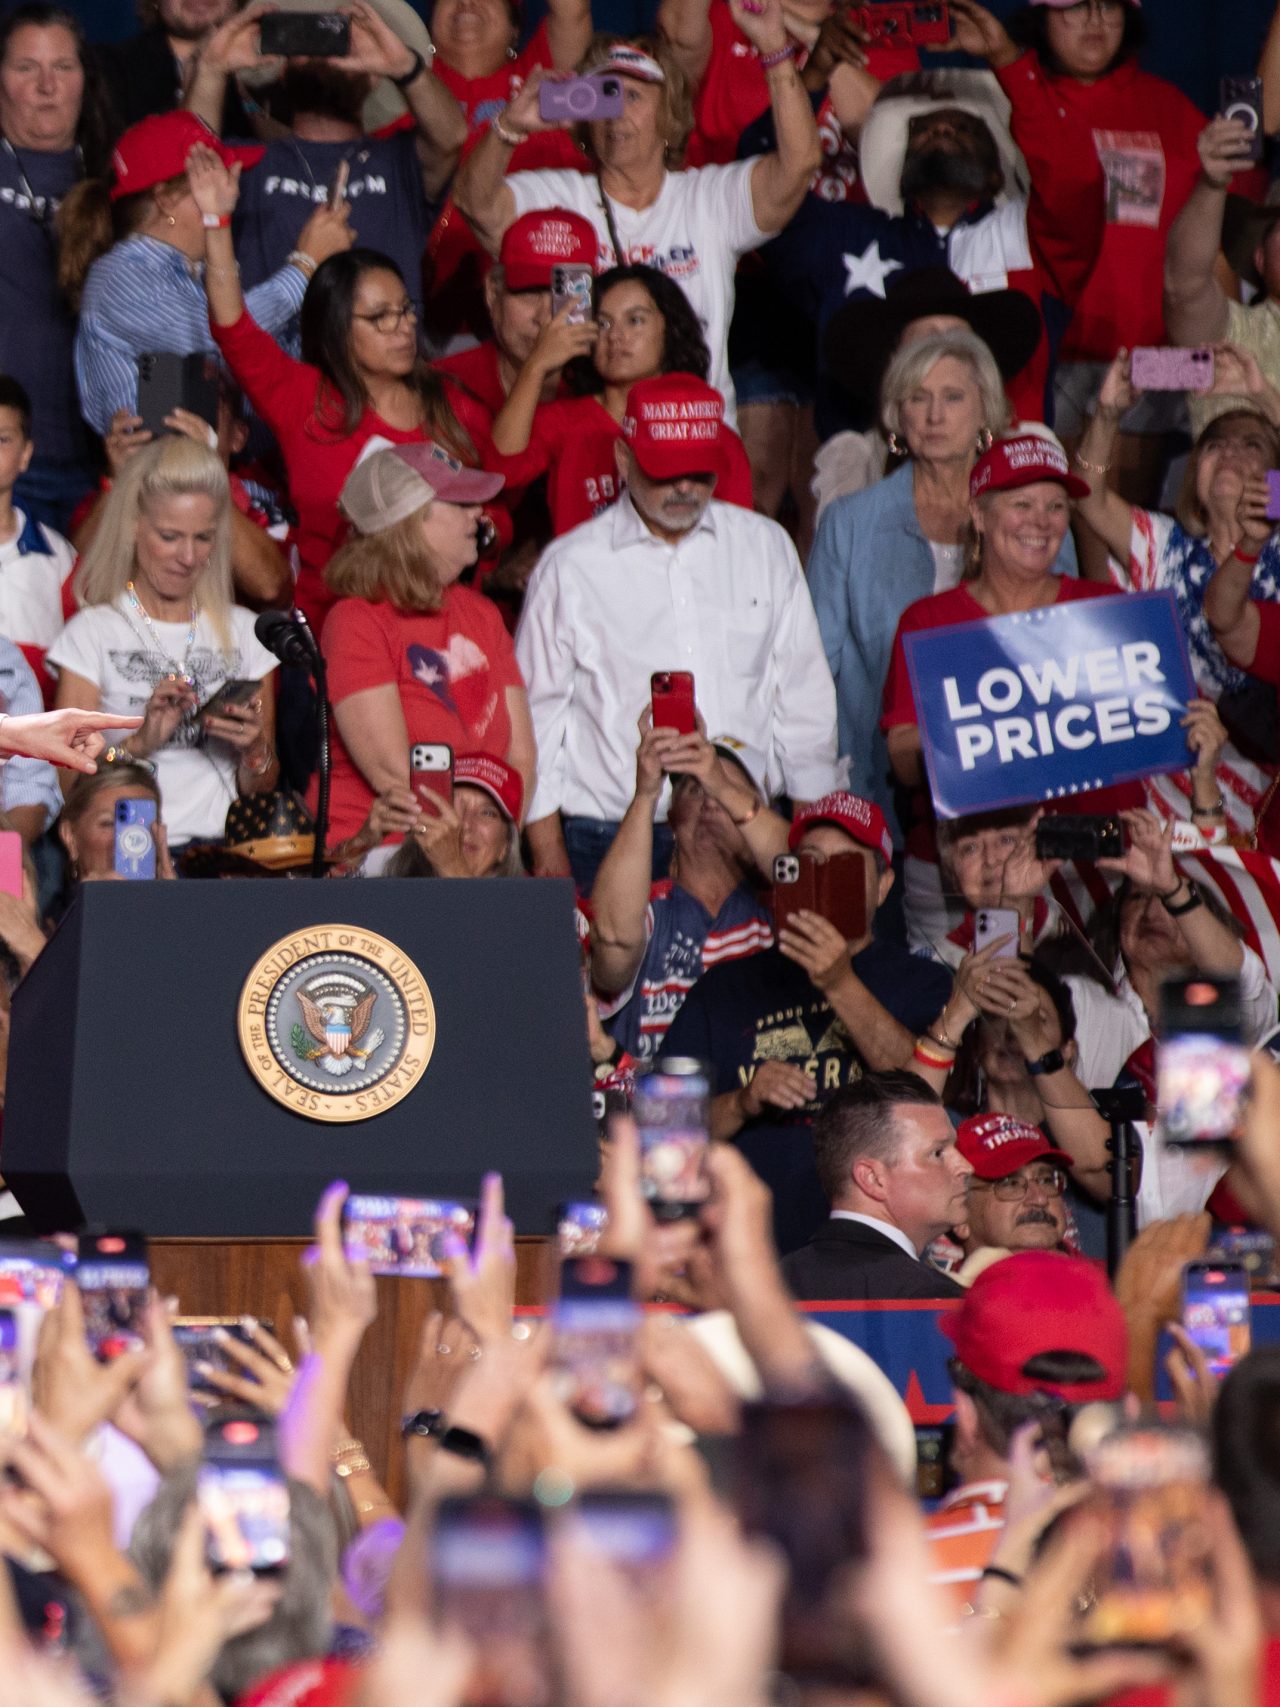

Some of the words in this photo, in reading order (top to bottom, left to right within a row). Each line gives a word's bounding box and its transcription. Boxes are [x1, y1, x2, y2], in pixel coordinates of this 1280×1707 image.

[642, 401, 678, 419] MAKE
[680, 400, 721, 419] AMERIC
[650, 421, 689, 440] GREAT
[1003, 440, 1034, 457] MAKE
[1010, 453, 1044, 470] GREAT
[943, 641, 1166, 721] LOWER
[955, 691, 1171, 771] PRICES
[338, 934, 357, 947] OF
[360, 938, 384, 958] THE
[248, 931, 333, 1016] PRESIDENT
[388, 956, 430, 1037] UNITED
[756, 1005, 803, 1031] PROUD
[250, 1023, 264, 1049] THE
[258, 1055, 271, 1071] OF
[271, 1069, 321, 1111] SEAL
[354, 1053, 421, 1112] STATES
